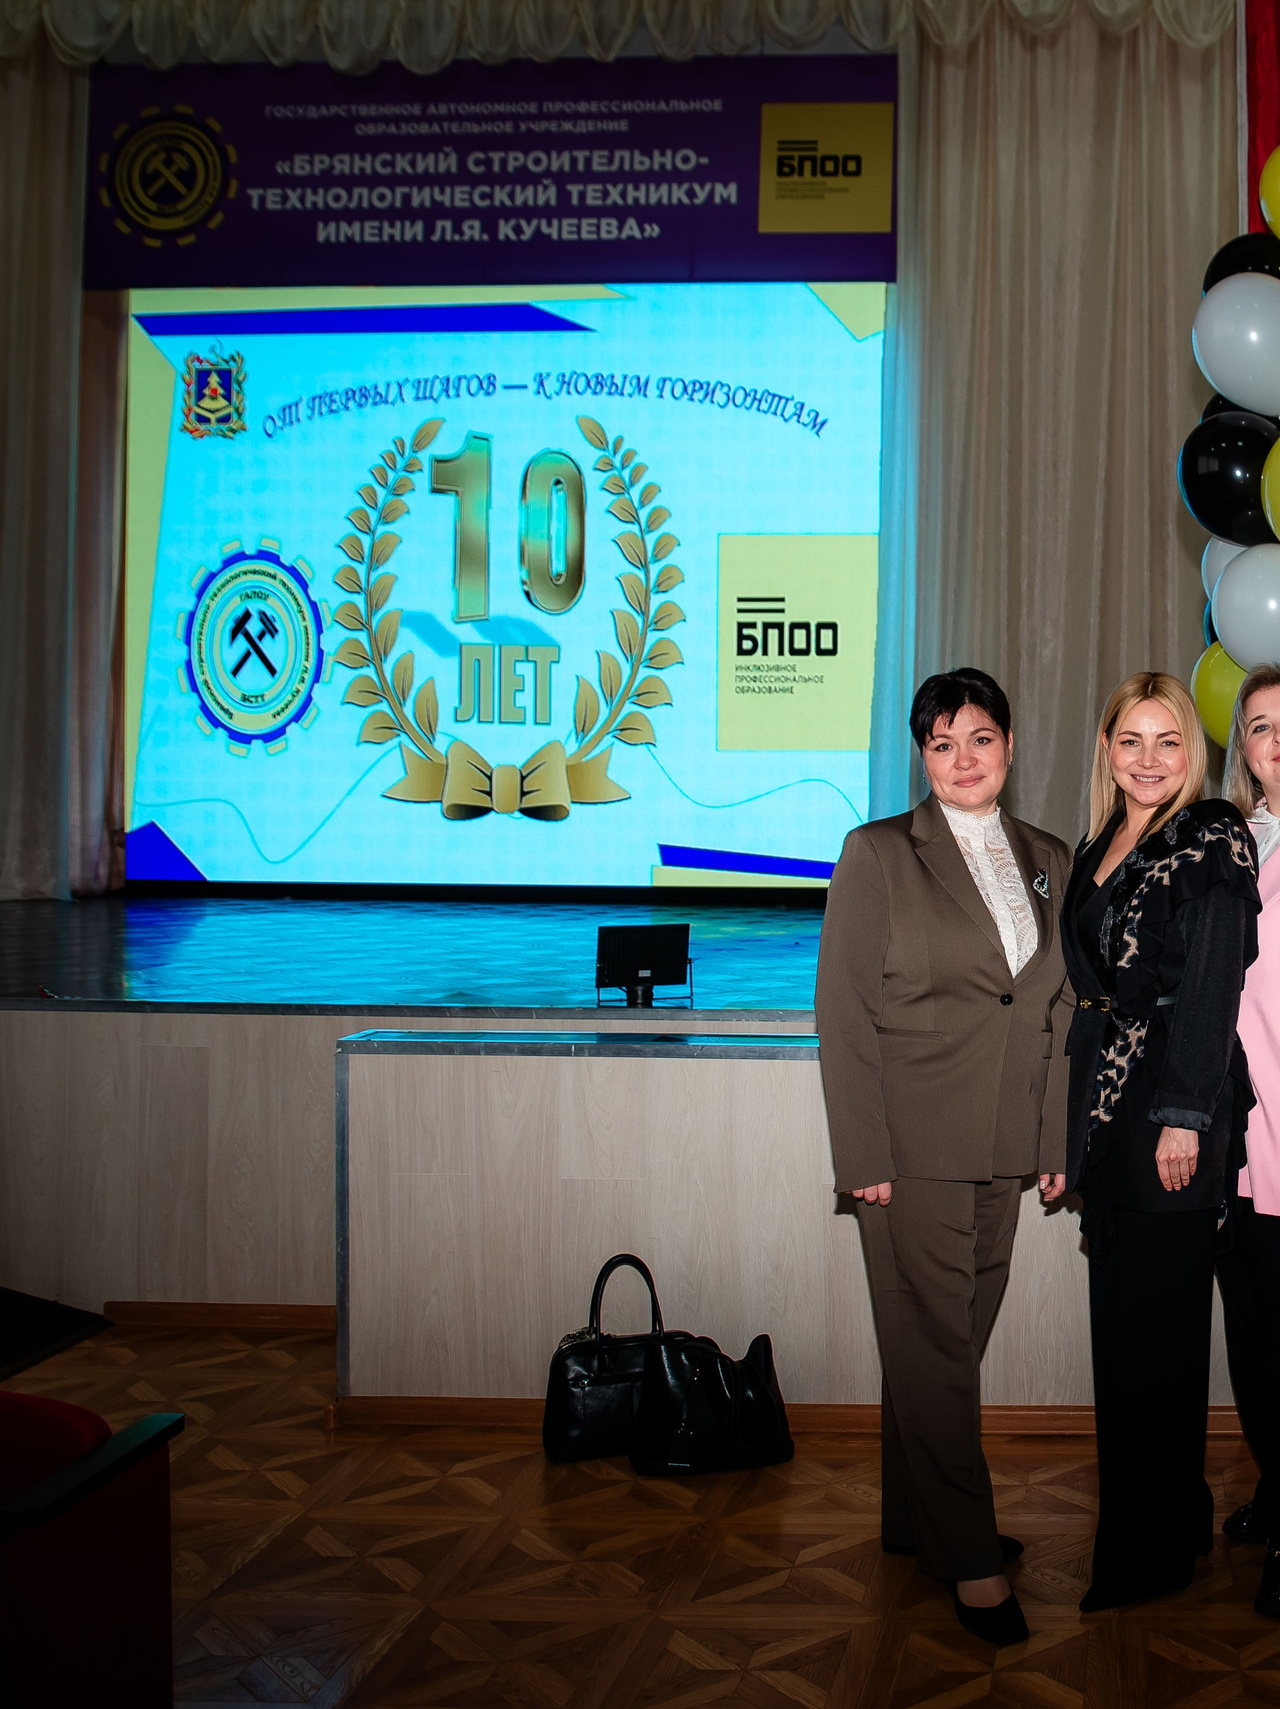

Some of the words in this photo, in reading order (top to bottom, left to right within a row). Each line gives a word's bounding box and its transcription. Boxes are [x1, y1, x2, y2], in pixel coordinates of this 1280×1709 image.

[264, 102, 423, 120] ГОСУДАРСТВЕННОЕ
[426, 101, 539, 117] АВТОНОМНОЕ
[542, 98, 724, 115] ПРОФЕССИОНАЛЬНОЕ
[354, 119, 515, 136] ОБРАЗОВАТЕЛЬНОЕ
[518, 118, 630, 135] УЧРЕЖДЕНИЕ
[275, 146, 459, 177] «БРЯНСКИЙ
[466, 147, 711, 175] СТРОИТЕЛЬНО-
[777, 154, 862, 177] БПОО
[246, 177, 558, 212] ТЕХНОЛОГИЧЕСКИЙ
[565, 181, 738, 207] ТЕХНИКУМ
[316, 219, 425, 244] ИМЕНИ
[430, 218, 491, 243] Л.Я.
[497, 215, 662, 242] КУЧЕЕВА»
[306, 377, 410, 421] ПЕРВЫХ
[532, 370, 553, 400] К
[554, 369, 652, 399] НОВЫМ
[655, 376, 830, 438] ГОРИЗОНТАМ
[428, 430, 587, 623] 10
[736, 621, 839, 657] БПОО
[734, 663, 797, 673] ИНКЛЮЗИВНОЕ
[734, 674, 825, 684] ПРОФЕССИОНАЛЬНОЕ
[454, 642, 561, 725] ЛЕТ
[734, 685, 795, 695] ОБРАЗОВАНИЕ
